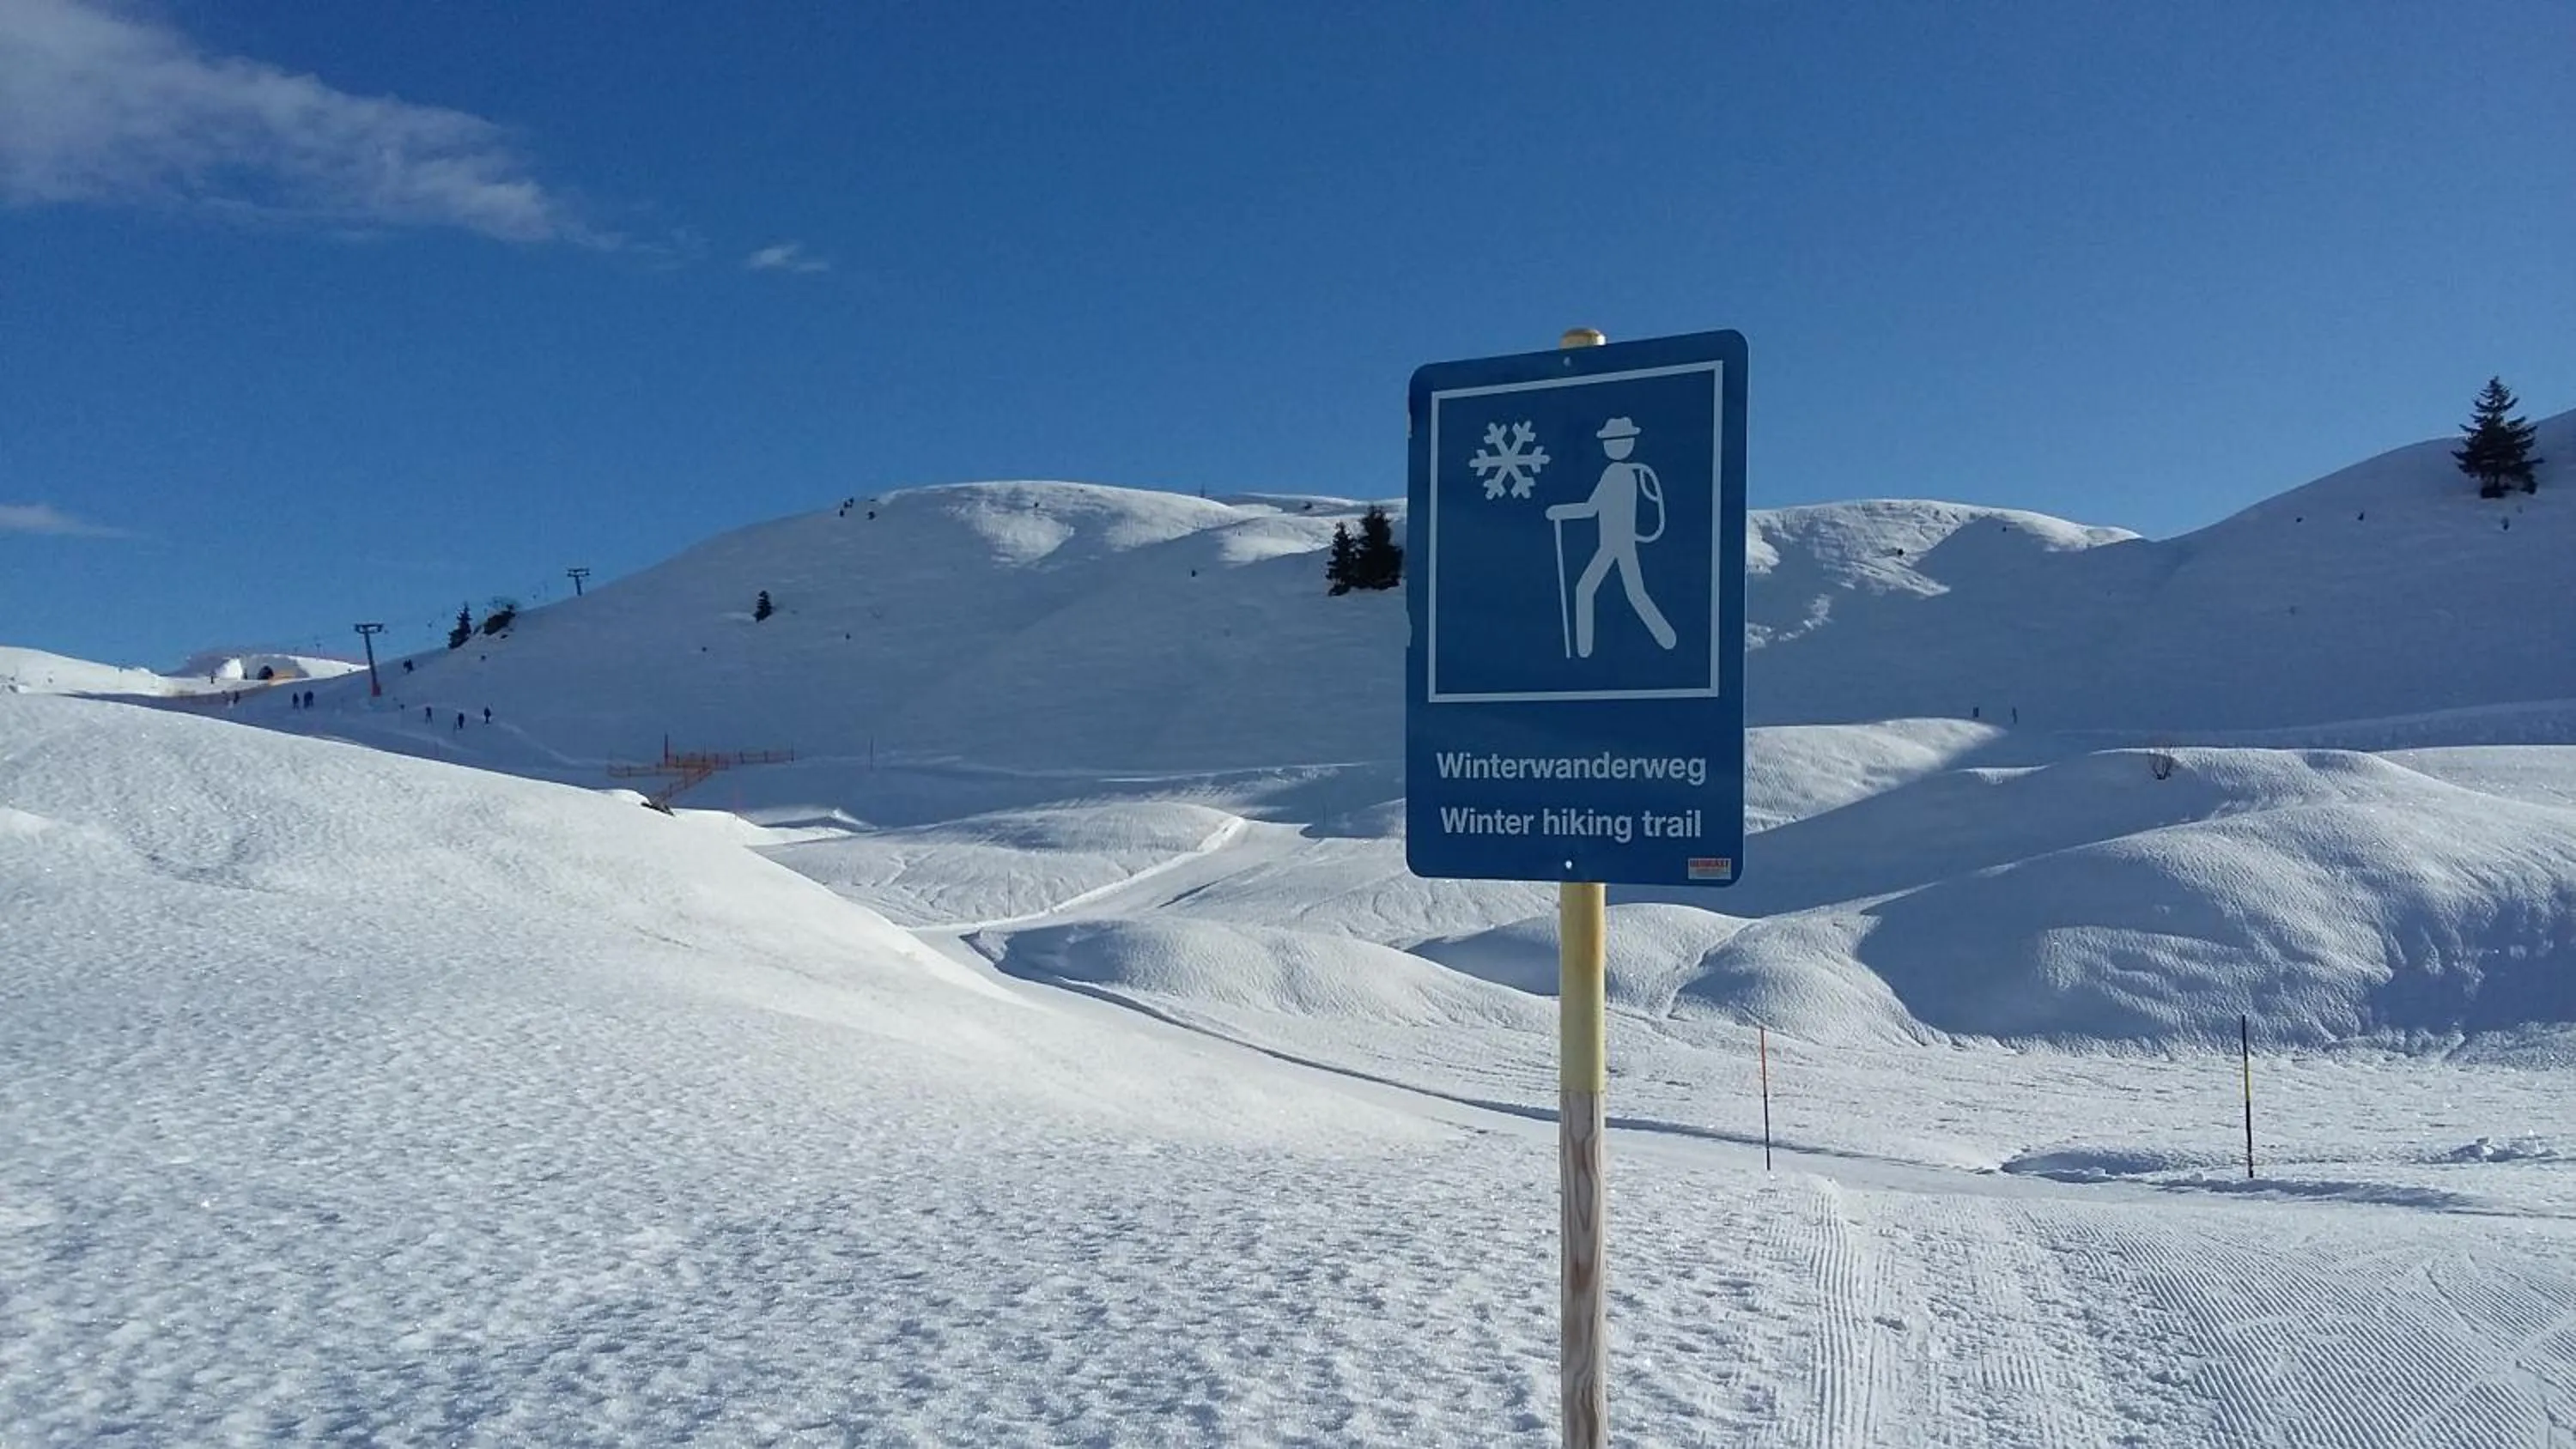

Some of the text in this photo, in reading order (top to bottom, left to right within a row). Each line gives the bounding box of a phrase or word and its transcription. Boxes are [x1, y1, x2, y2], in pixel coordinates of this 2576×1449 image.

[1436, 751, 1707, 785] Winterwanderweg
[1440, 807, 1702, 843] Winter hiking trail
